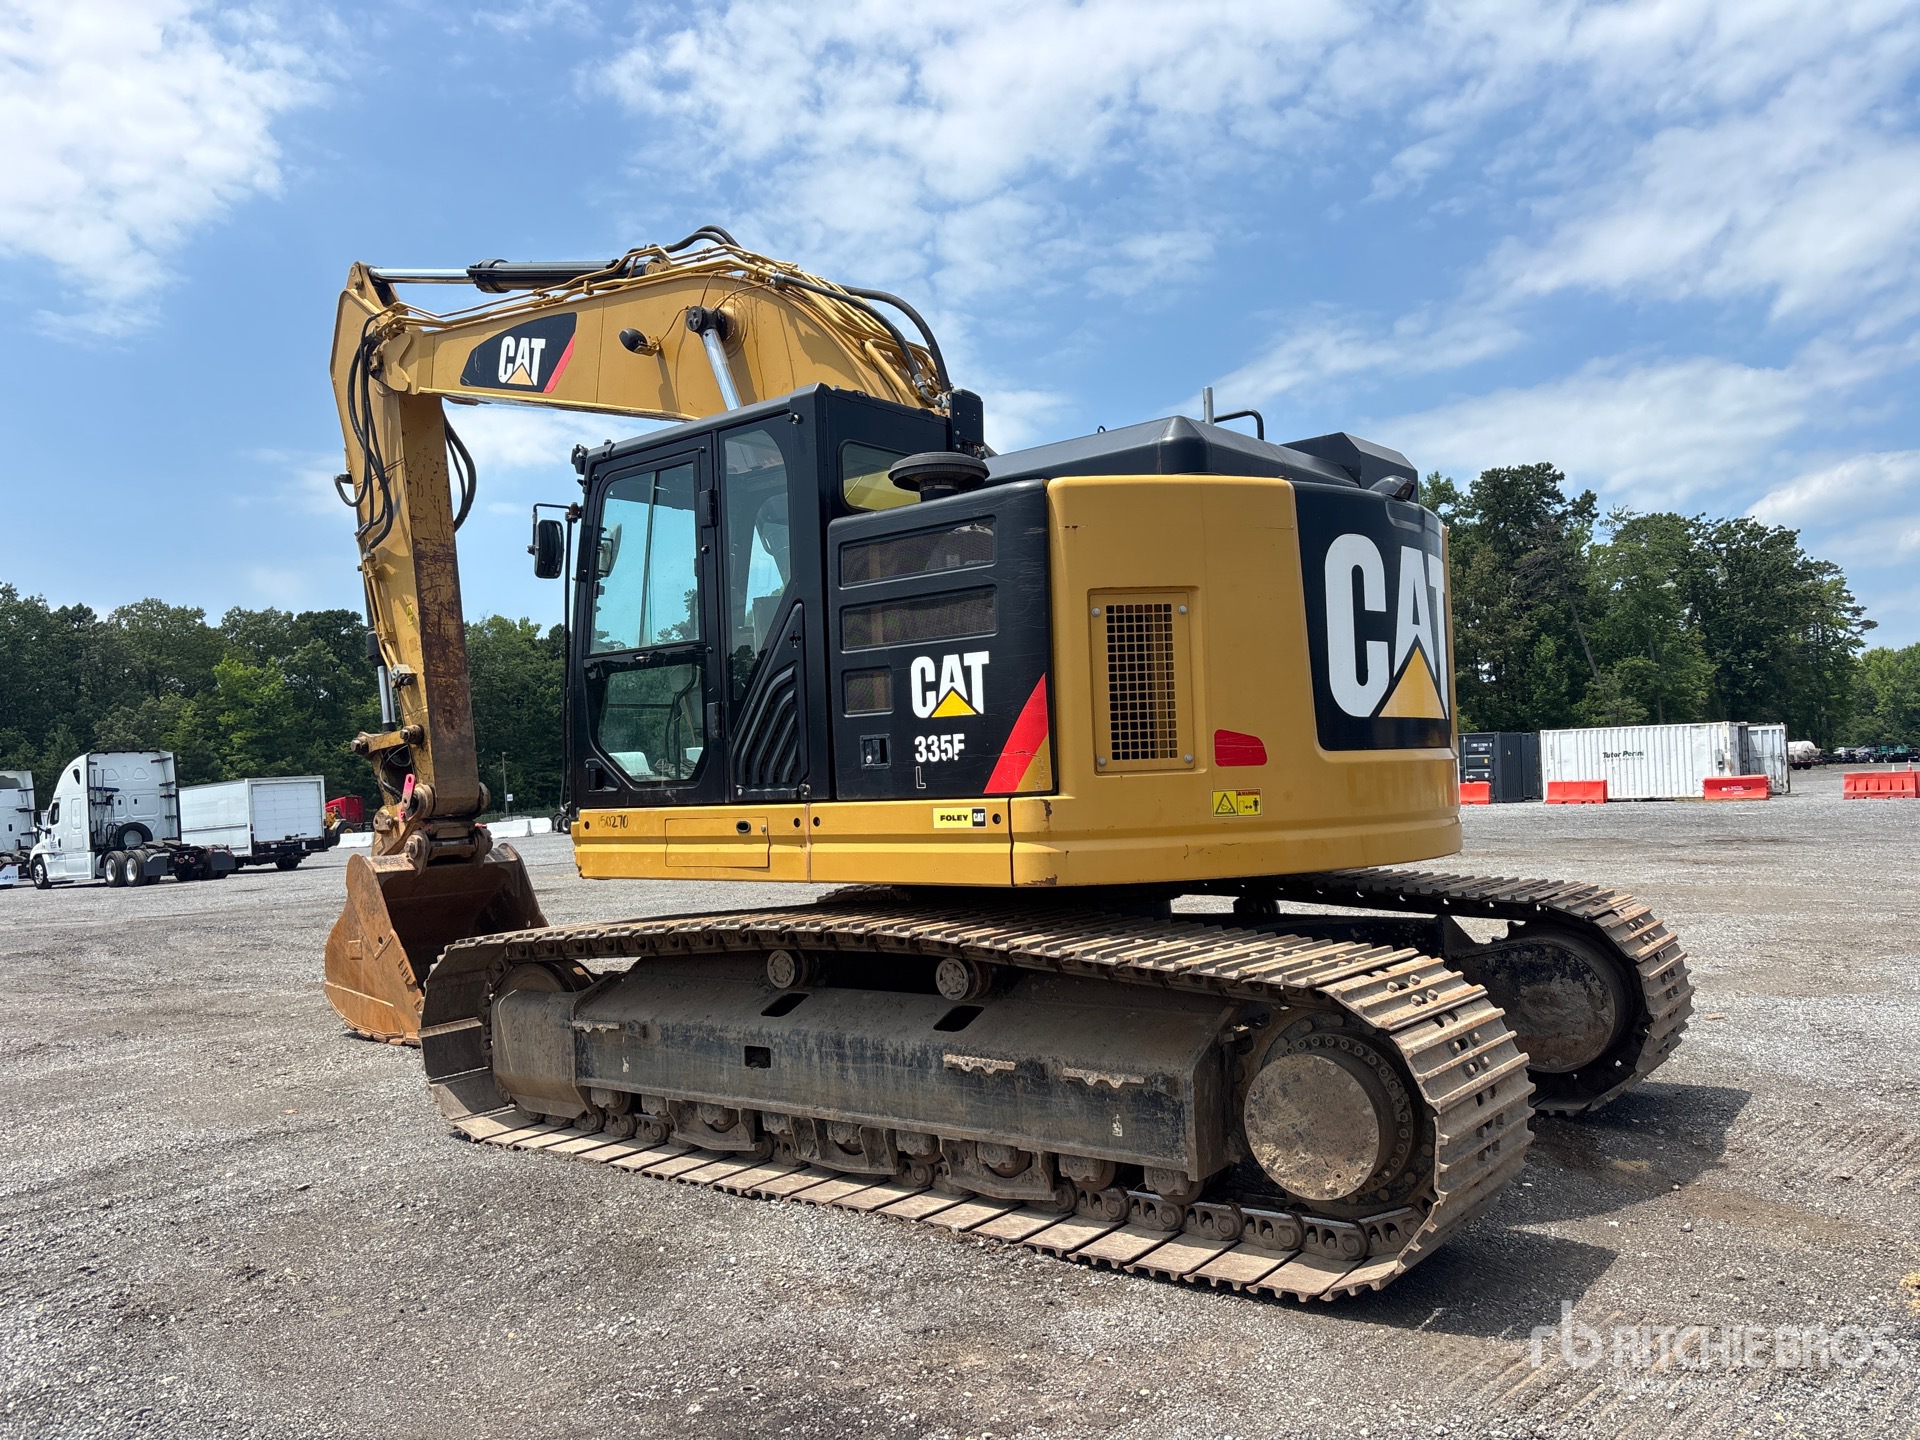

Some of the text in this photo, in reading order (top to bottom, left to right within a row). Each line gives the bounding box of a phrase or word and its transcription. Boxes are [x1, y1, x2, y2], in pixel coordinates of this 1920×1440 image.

[498, 335, 546, 386] CAT
[1325, 533, 1450, 720] CAT
[910, 651, 990, 719] CAT
[914, 733, 965, 763] 335F
[915, 766, 927, 789] L
[940, 812, 985, 822] FOLEY CAT
